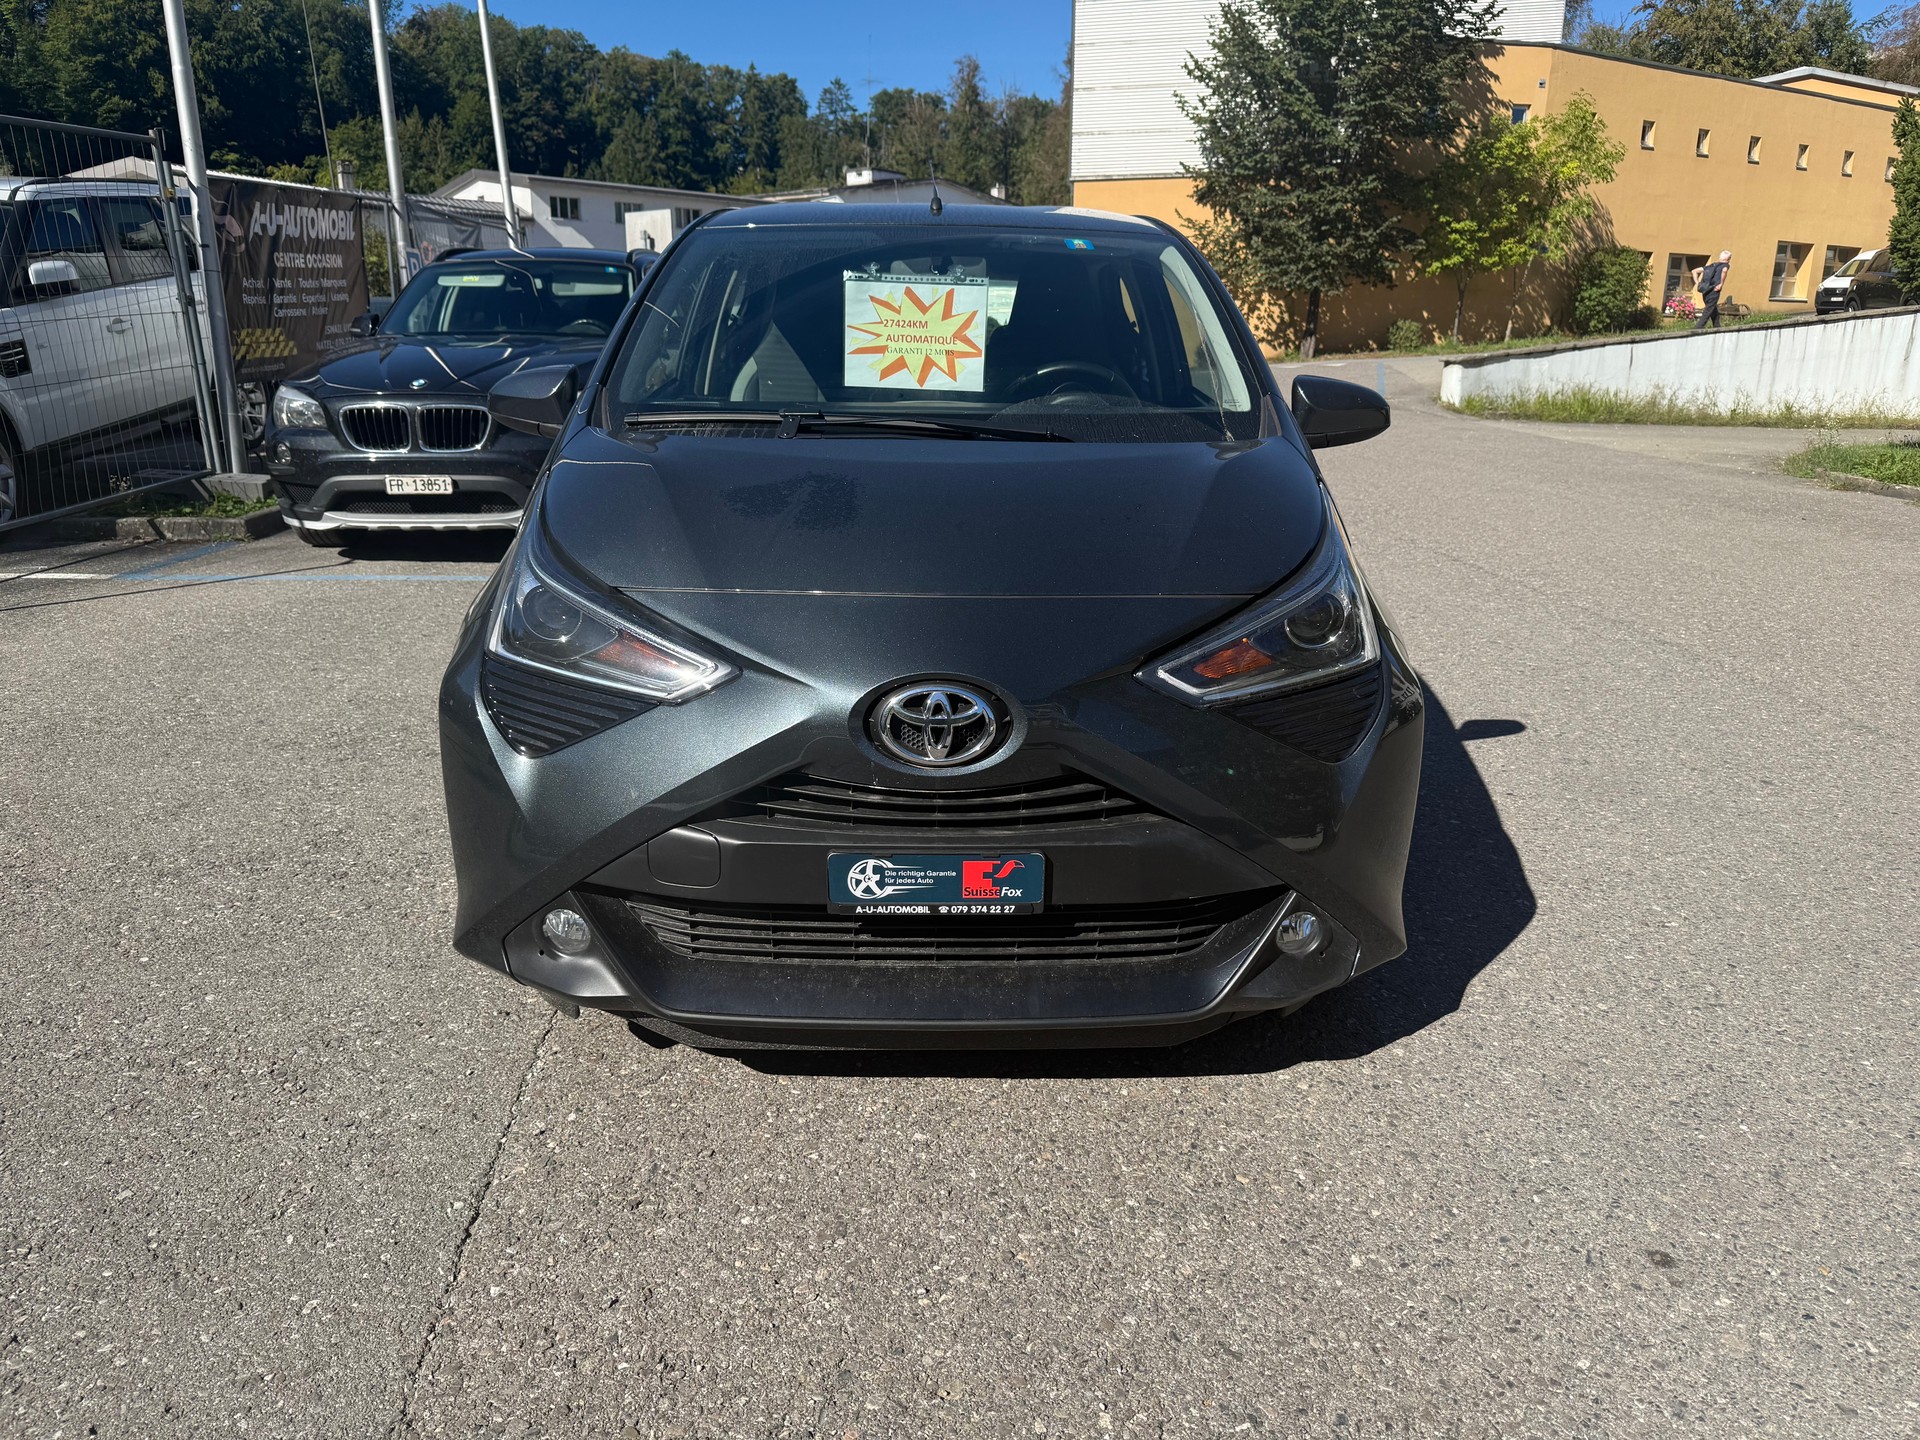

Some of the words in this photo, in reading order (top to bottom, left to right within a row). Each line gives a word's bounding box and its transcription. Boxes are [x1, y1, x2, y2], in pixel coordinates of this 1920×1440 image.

[249, 201, 355, 245] A-U-AUTOMOBIL
[273, 252, 304, 268] CENTRE
[306, 253, 343, 268] OCCASION
[242, 277, 265, 288] Achat
[273, 277, 292, 288] Vente
[320, 277, 347, 289] Marques
[883, 319, 928, 329] 27424KM
[886, 333, 957, 346] AUTOMATIQUE
[887, 347, 922, 355] GARANTI
[925, 347, 932, 355] 12
[934, 347, 955, 356] MOIS
[389, 479, 404, 492] FR
[412, 479, 448, 491] 13851
[898, 870, 925, 879] richtige
[896, 877, 915, 885] jedes
[856, 905, 931, 914] A-U-AUTOMOBIL
[951, 905, 968, 914] 079
[970, 905, 987, 914] 374
[990, 905, 1001, 914] 22
[1003, 905, 1015, 914] 27
